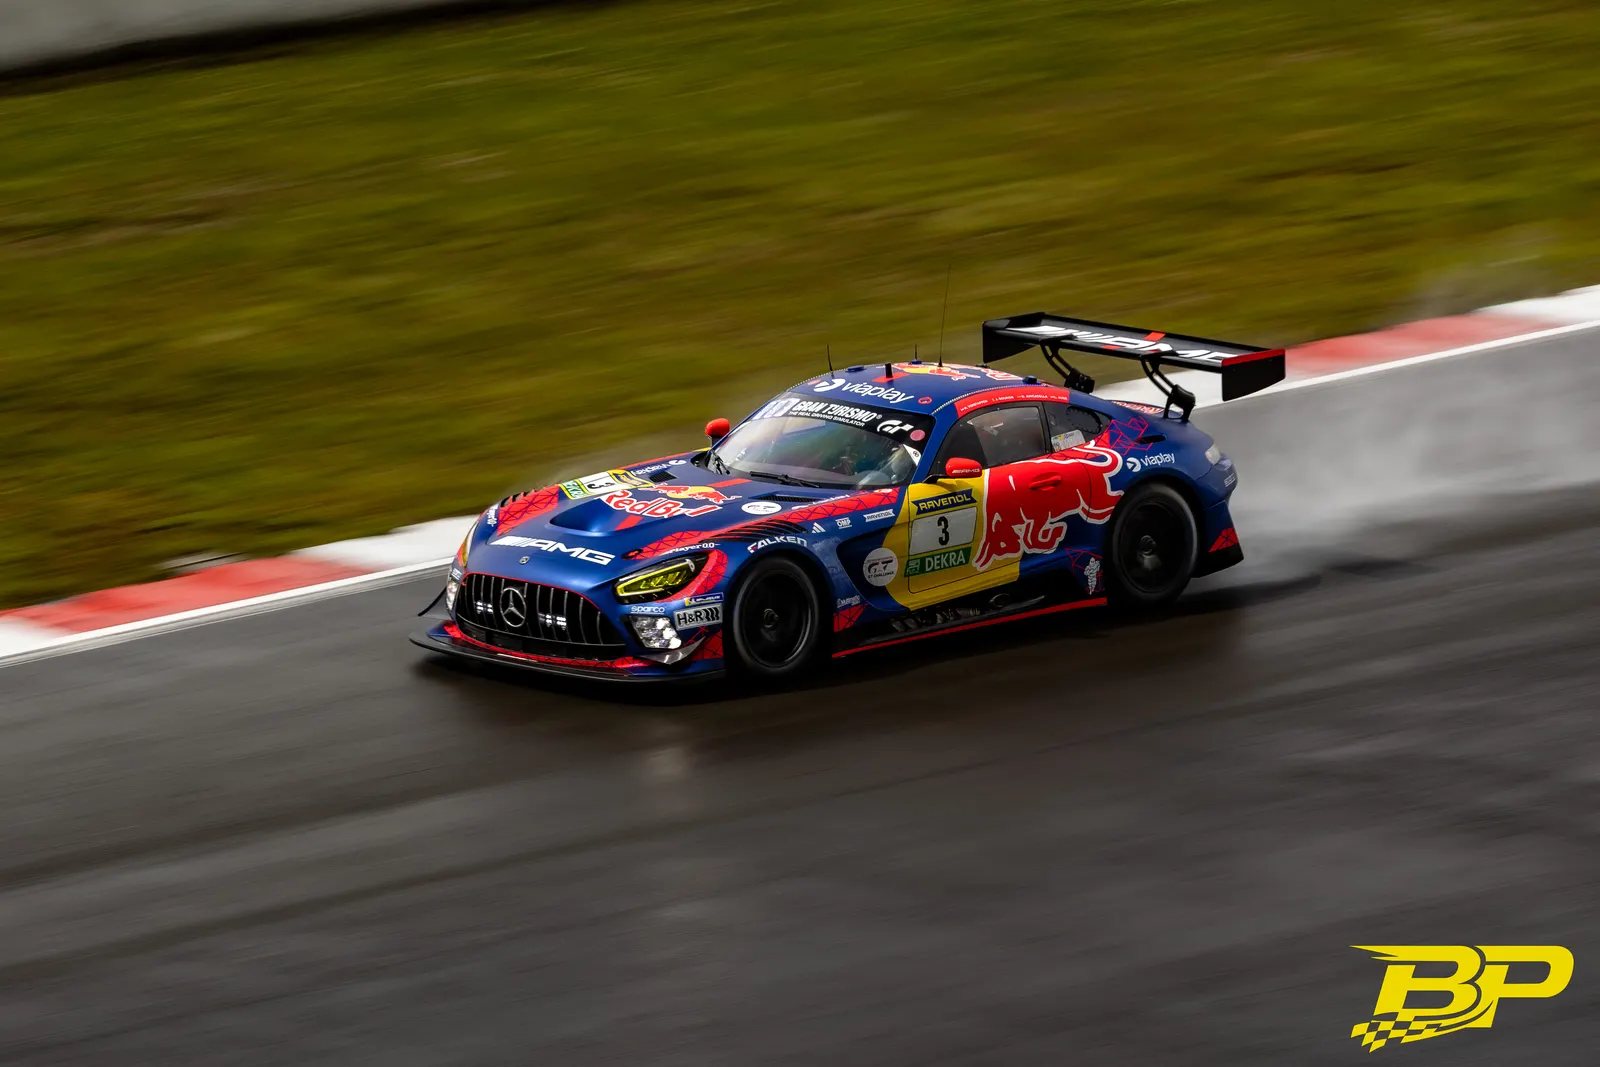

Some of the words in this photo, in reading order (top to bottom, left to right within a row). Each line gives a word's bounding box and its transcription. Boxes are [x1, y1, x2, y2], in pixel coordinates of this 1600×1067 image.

[841, 382, 914, 404] viaplay
[792, 401, 826, 413] GRAN
[811, 412, 833, 420] DRIVING
[833, 416, 866, 427] SIMULATOR
[1140, 452, 1176, 467] viaplay
[918, 494, 971, 511] RAVENOL
[837, 519, 851, 527] OMP
[866, 512, 893, 520] RAVENOL
[937, 516, 950, 546] 3
[529, 539, 616, 566] AMG
[747, 535, 808, 554] FALKEN
[925, 550, 966, 572] DEKRA
[631, 606, 665, 614] sparco
[677, 610, 704, 626] H&R
